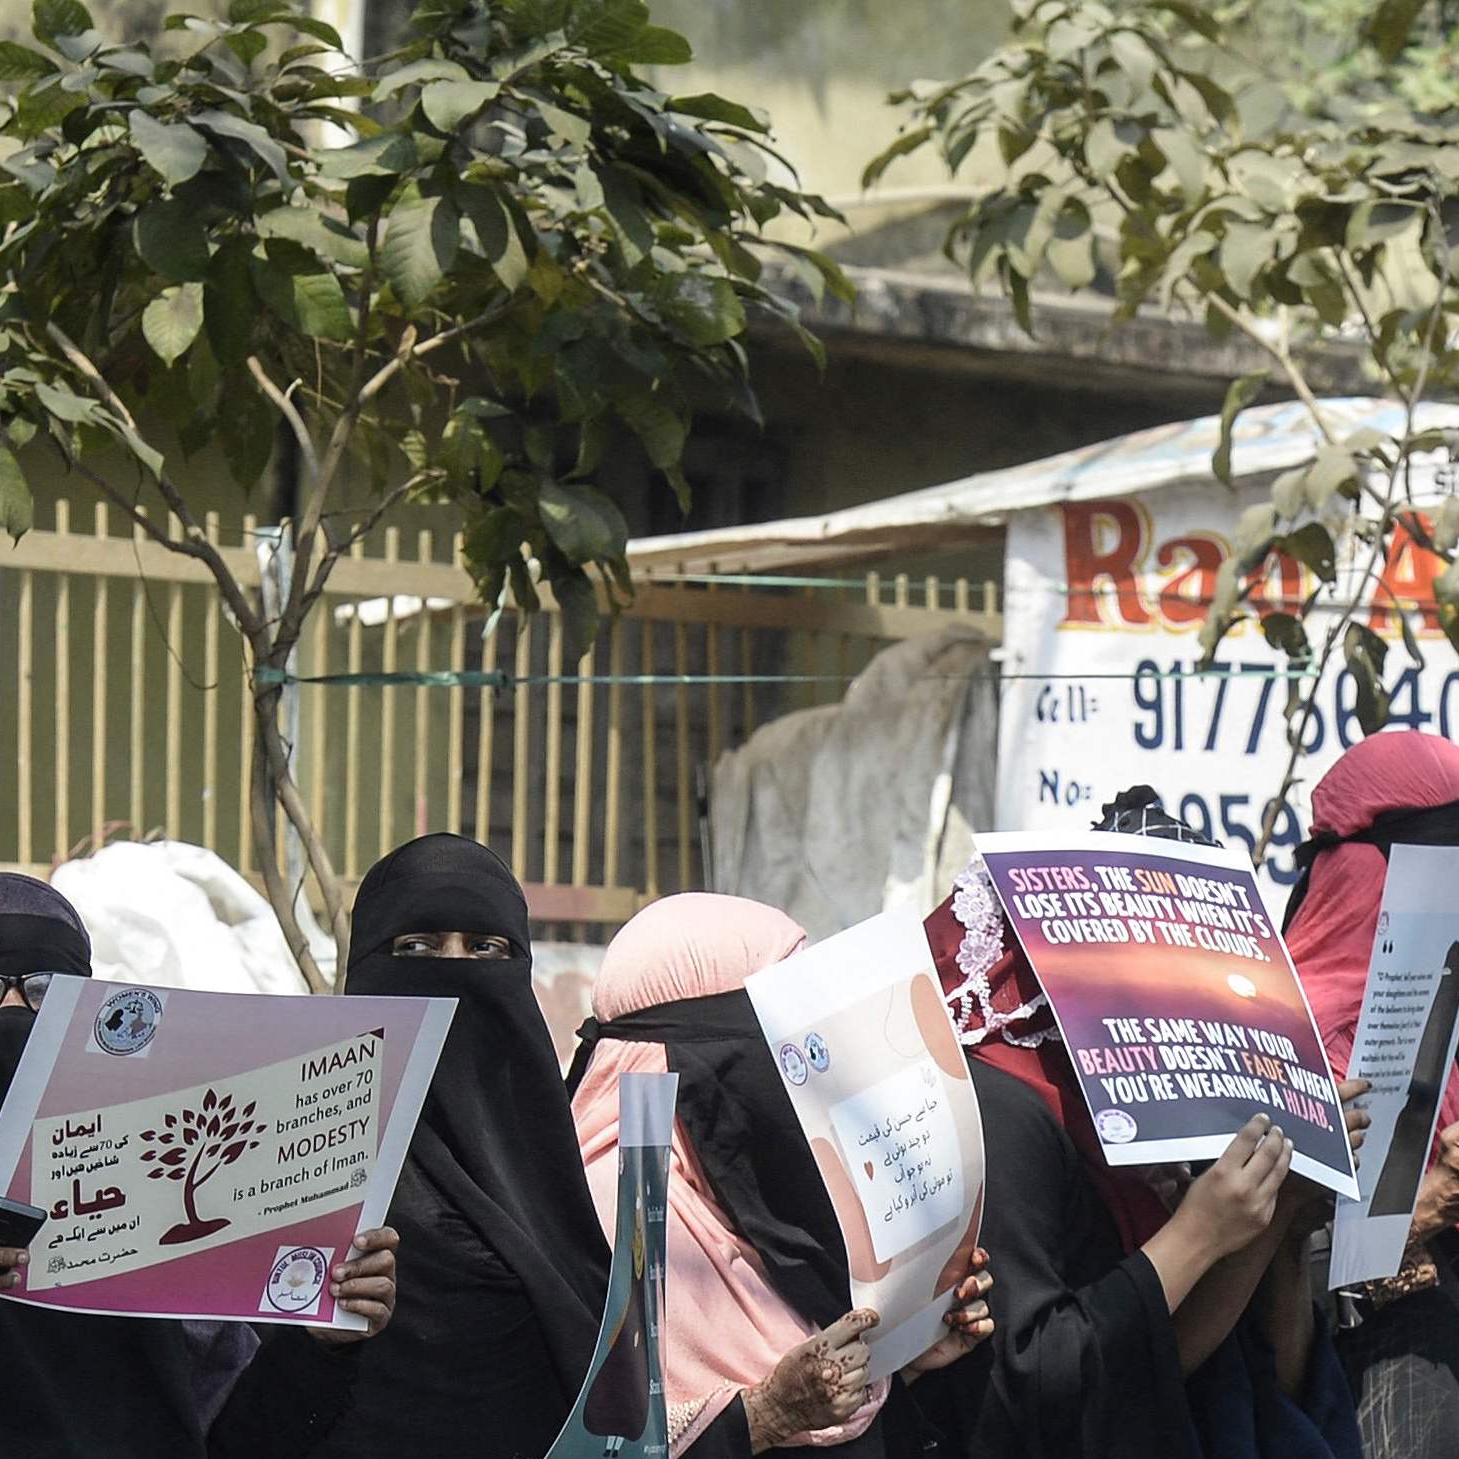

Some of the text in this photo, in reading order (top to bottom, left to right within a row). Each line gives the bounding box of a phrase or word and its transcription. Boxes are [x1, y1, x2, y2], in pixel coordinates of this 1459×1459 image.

[1007, 866, 1251, 910] SISTERS, THE SUN DOESN'T
[1012, 891, 1272, 939] LOSE ITS BEAUTY WHEN IT'S
[1041, 918, 1271, 963] COVERED BY THE CLOUDS.
[301, 1039, 376, 1083] IMAAN
[1102, 1017, 1299, 1064] THE SAME WAY YOUR
[295, 1069, 373, 1109] has over 70
[1076, 1044, 1336, 1105] BEAUTY DOESN'T FADE WHEN
[276, 1088, 372, 1134] branches, and
[1100, 1072, 1334, 1132] YOU'RE WEARING A HIJAB.
[52, 1114, 101, 1145] ایمان
[99, 1139, 113, 1150] 70
[114, 1134, 129, 1150] کی
[277, 1115, 370, 1165] MODESTY
[51, 1165, 65, 1180] اور
[233, 1150, 369, 1202] is a branch of Iman.
[49, 1179, 126, 1221] حیاء
[263, 1181, 349, 1216] Prophet Muhammad
[87, 1226, 107, 1242] سے
[108, 1222, 127, 1236] میں
[129, 1215, 140, 1230] ان
[67, 1248, 139, 1270] حضرت محمد
